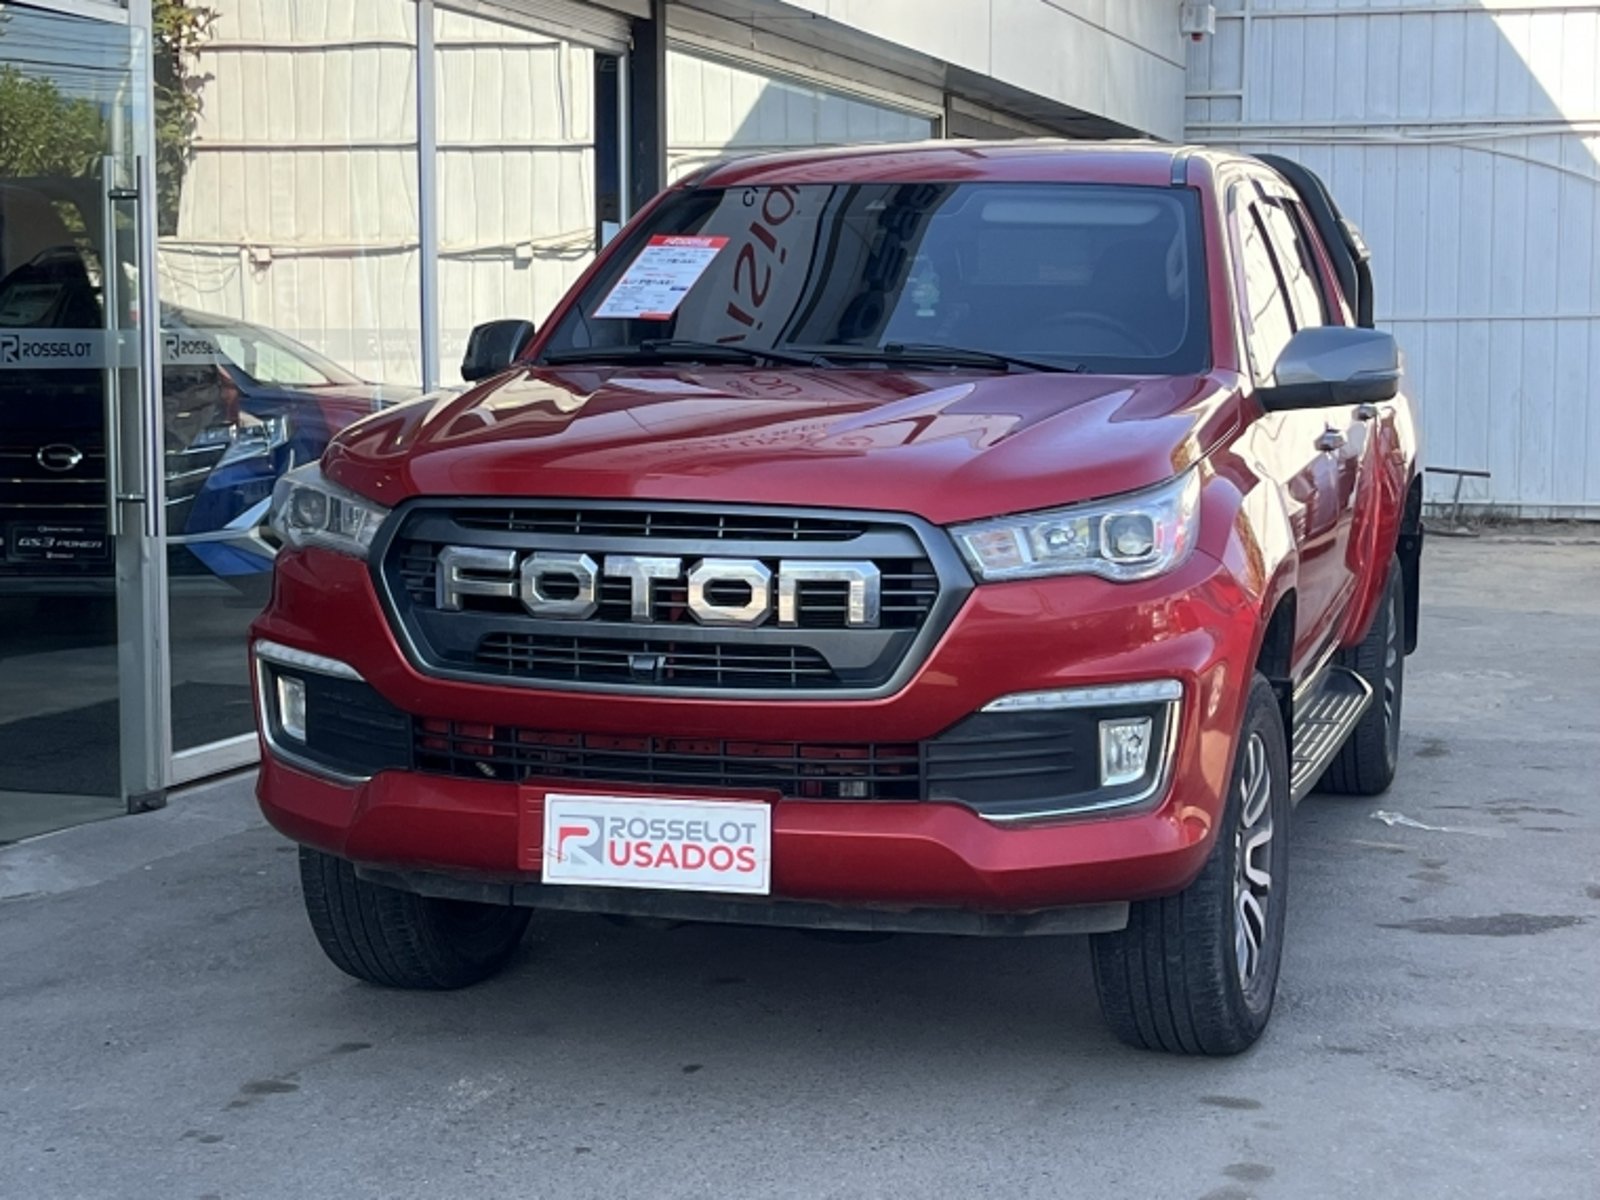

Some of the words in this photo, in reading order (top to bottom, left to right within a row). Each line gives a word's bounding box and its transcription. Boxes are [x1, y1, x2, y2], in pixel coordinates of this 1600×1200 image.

[22, 342, 92, 358] ROSSELOT
[436, 545, 881, 629] FOTON
[610, 816, 757, 845] ROSSELOT
[609, 840, 757, 873] USADOS
